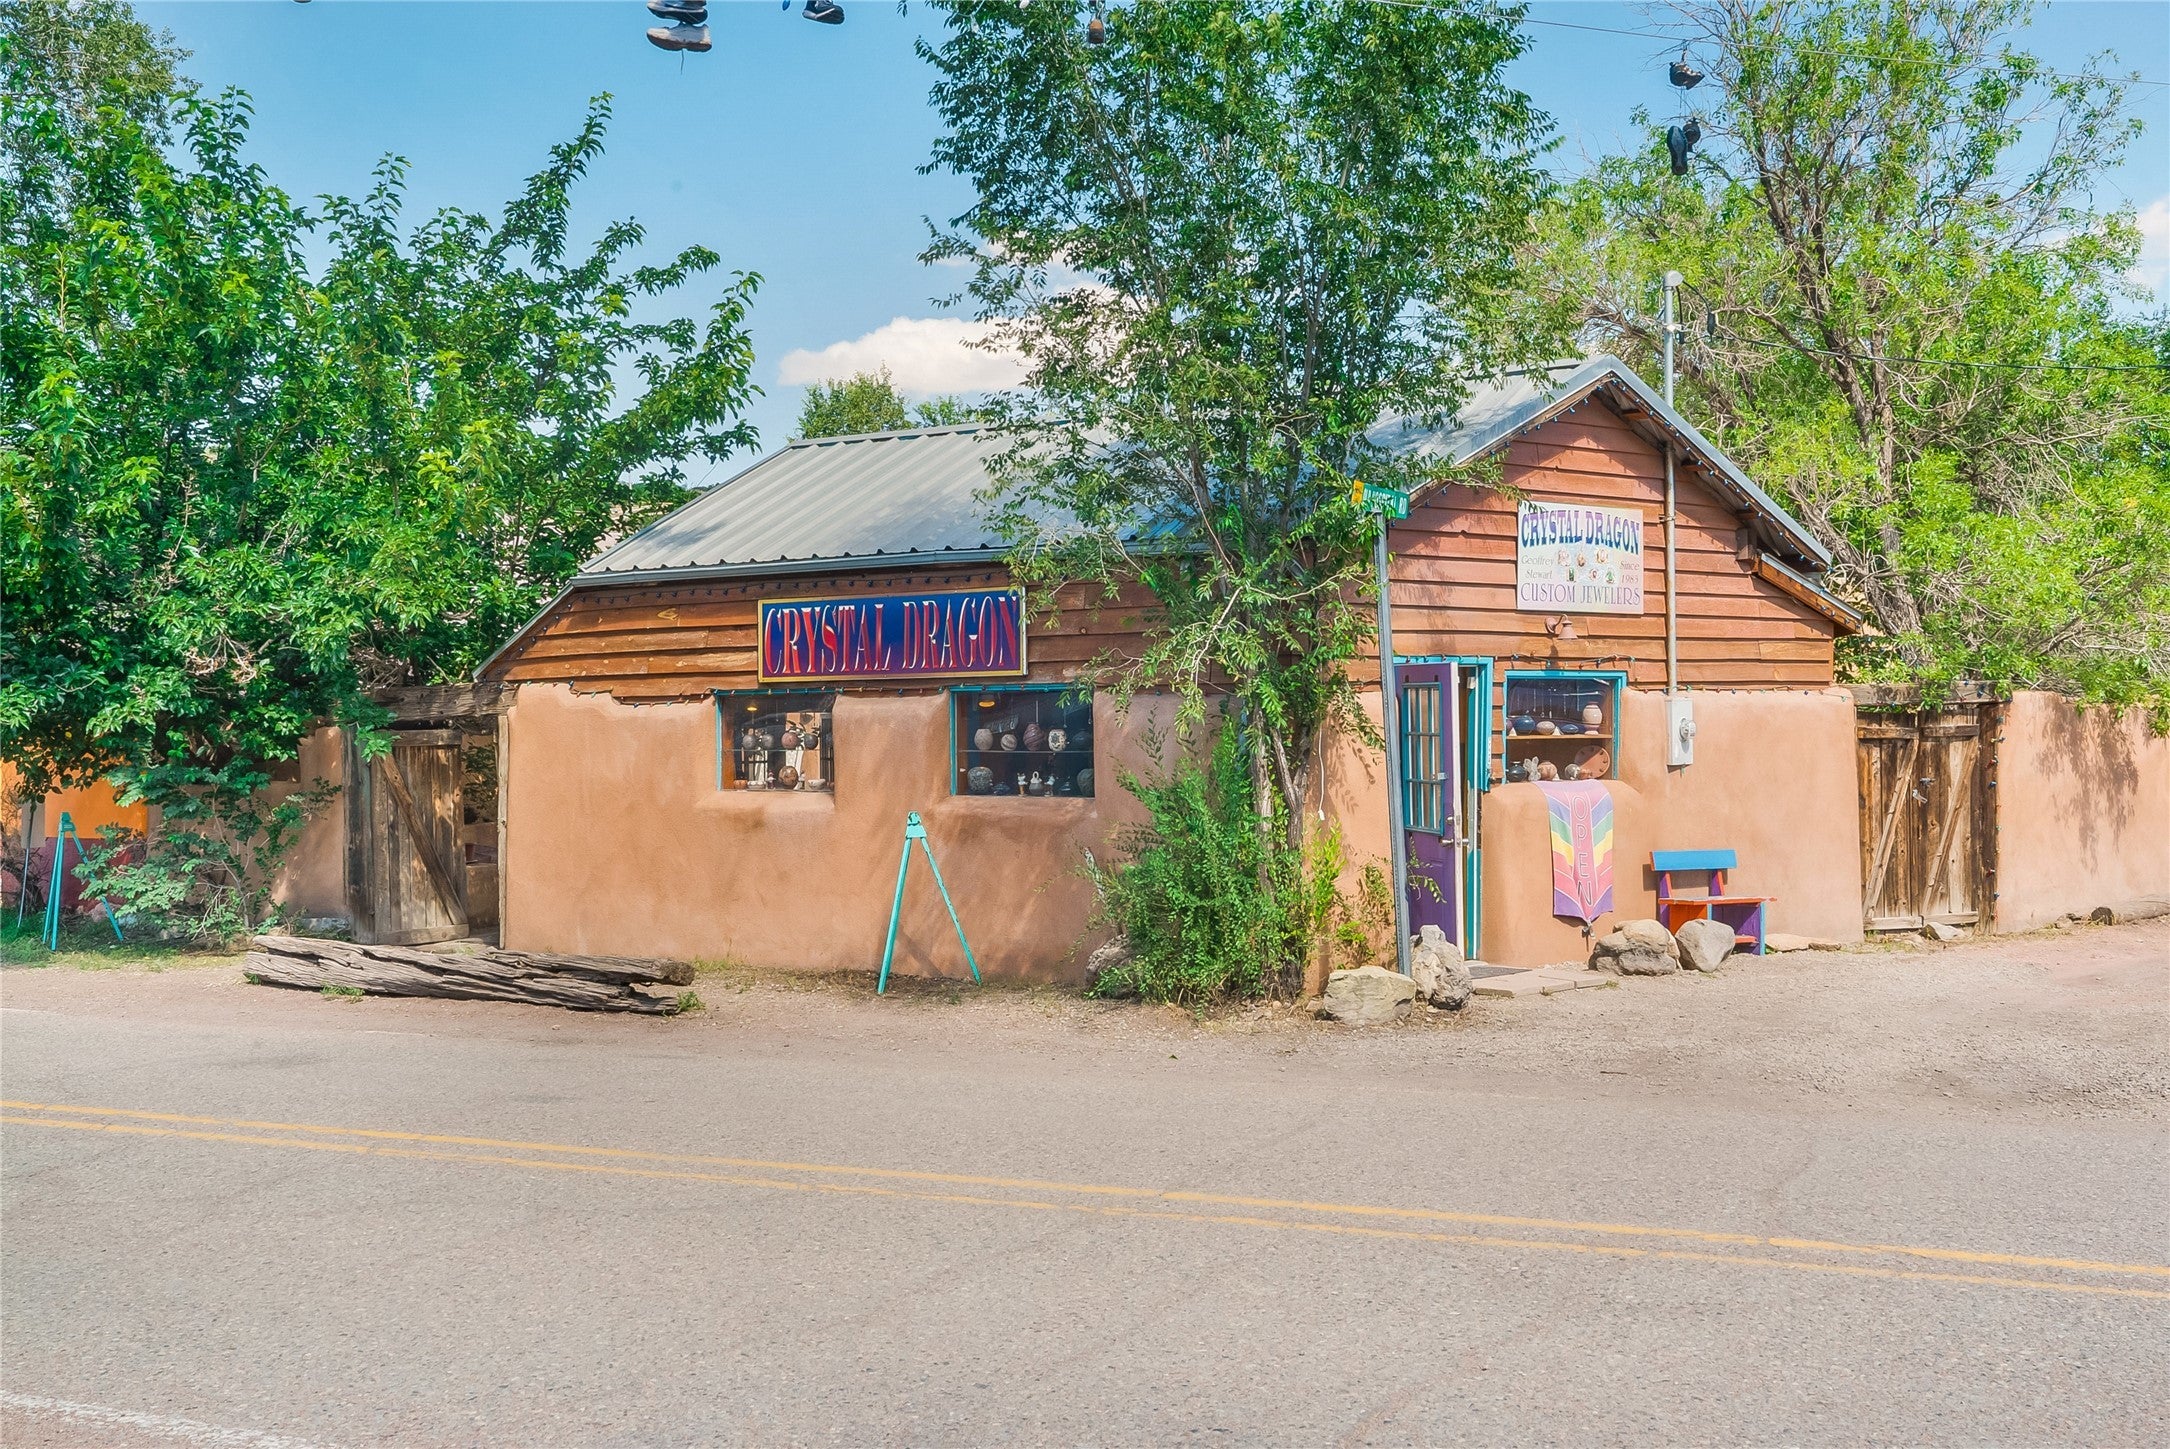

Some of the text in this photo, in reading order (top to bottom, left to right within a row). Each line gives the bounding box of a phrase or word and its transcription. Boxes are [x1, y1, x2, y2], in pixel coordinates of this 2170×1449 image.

[1521, 510, 1640, 555] CRYSTAL DRAGON
[1521, 554, 1554, 568] Geoffrey
[1620, 560, 1640, 570] Since
[1525, 569, 1552, 579] Stewart
[1520, 582, 1641, 605] CUSTOM JEWELERS
[765, 596, 1017, 674] CRYSTAL DRAGON
[1572, 796, 1593, 906] OPEN
